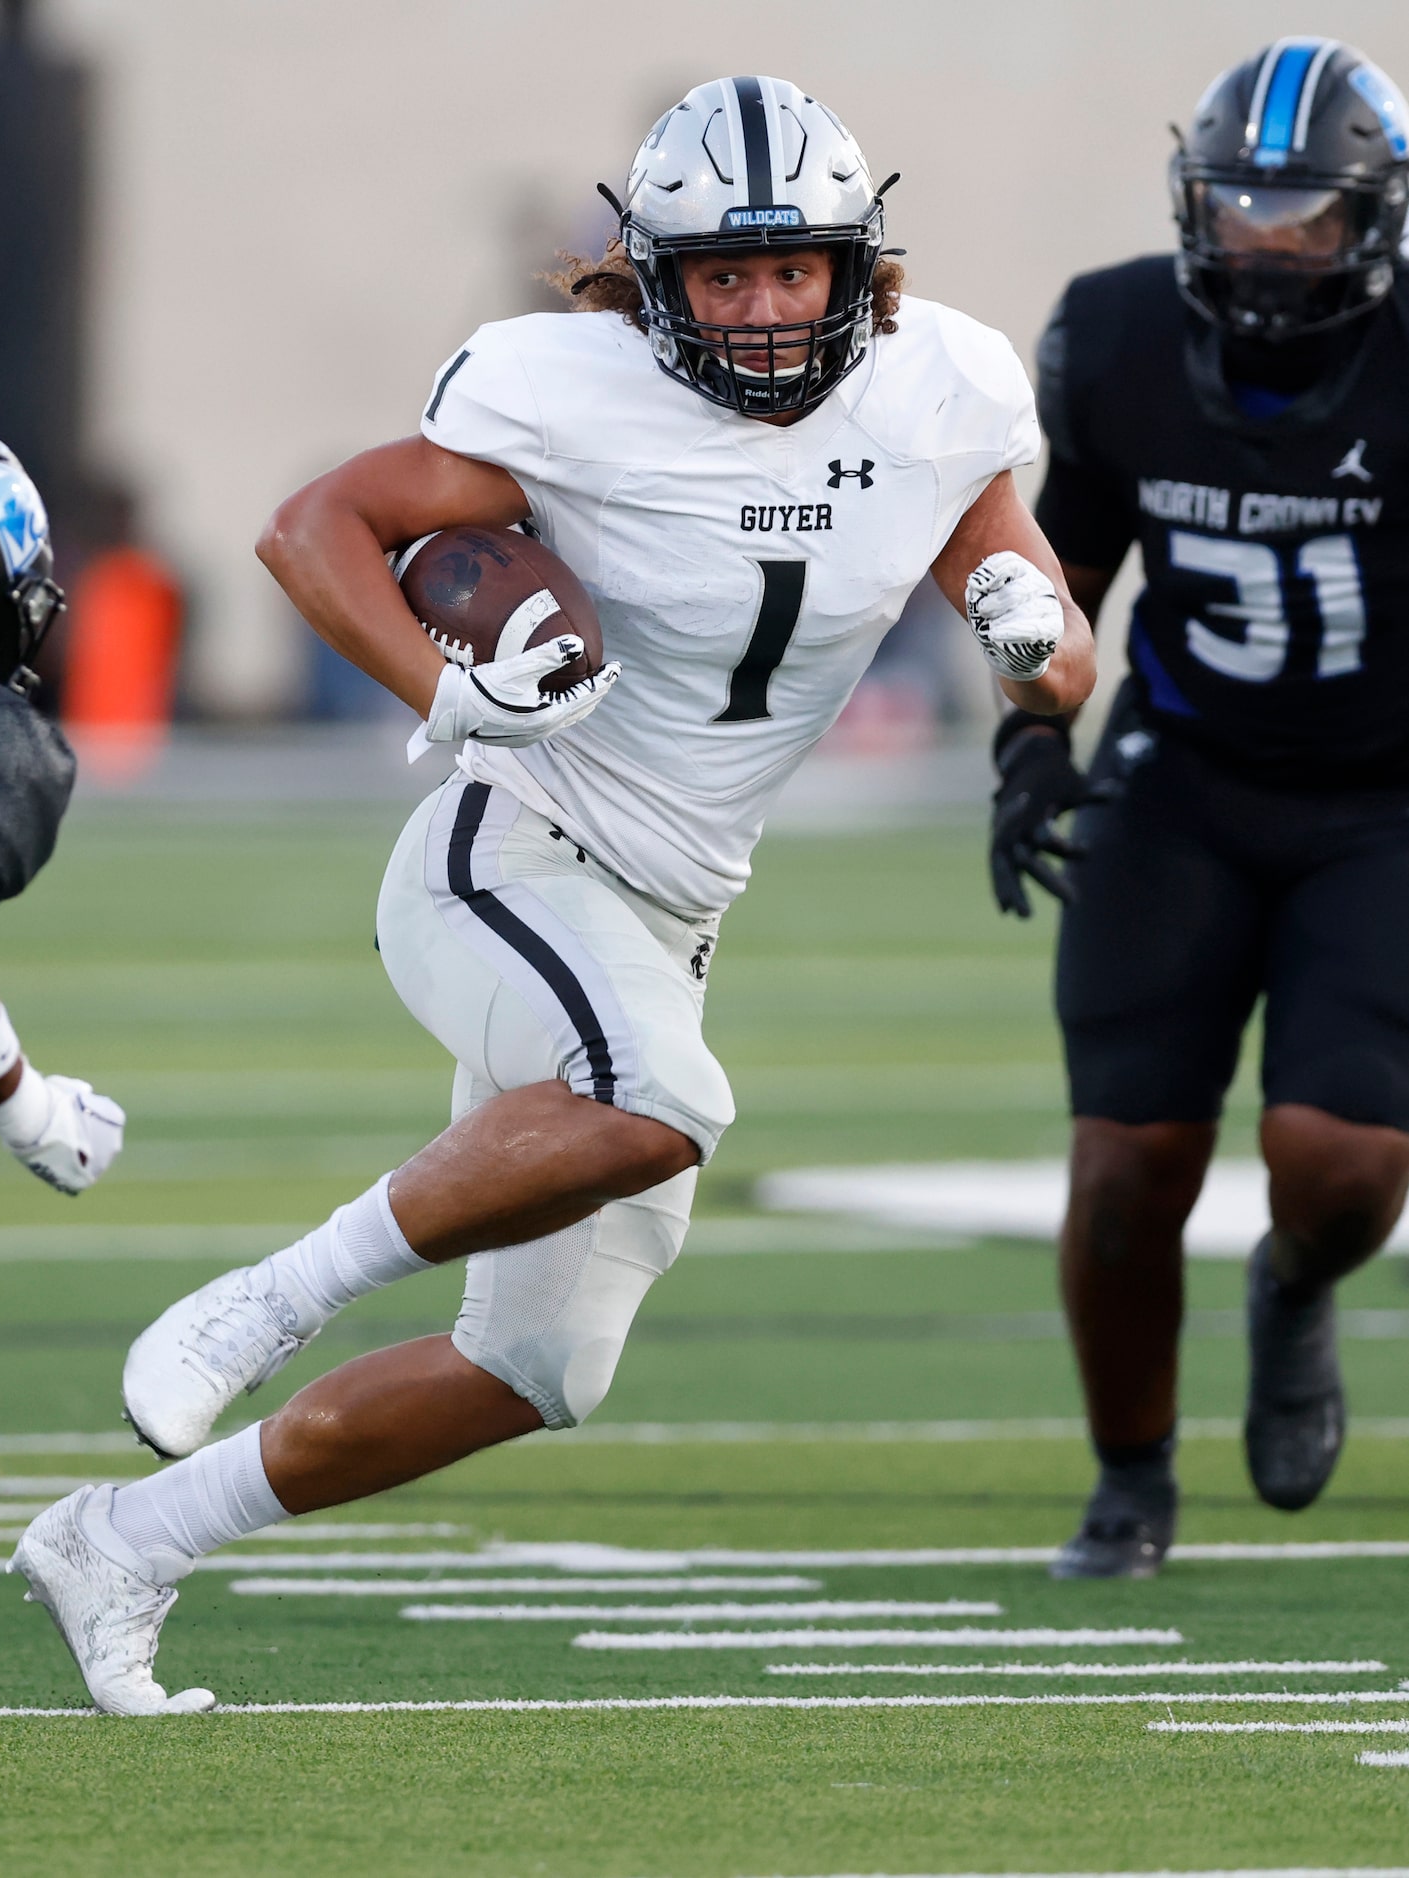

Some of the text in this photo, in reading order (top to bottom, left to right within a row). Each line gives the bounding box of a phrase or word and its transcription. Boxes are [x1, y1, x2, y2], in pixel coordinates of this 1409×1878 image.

[728, 209, 800, 227] WILDCATS
[425, 349, 472, 423] 1
[740, 503, 834, 532] GUYER
[1137, 477, 1231, 531] NORTH
[1169, 530, 1368, 684] 31
[705, 554, 812, 726] 1
